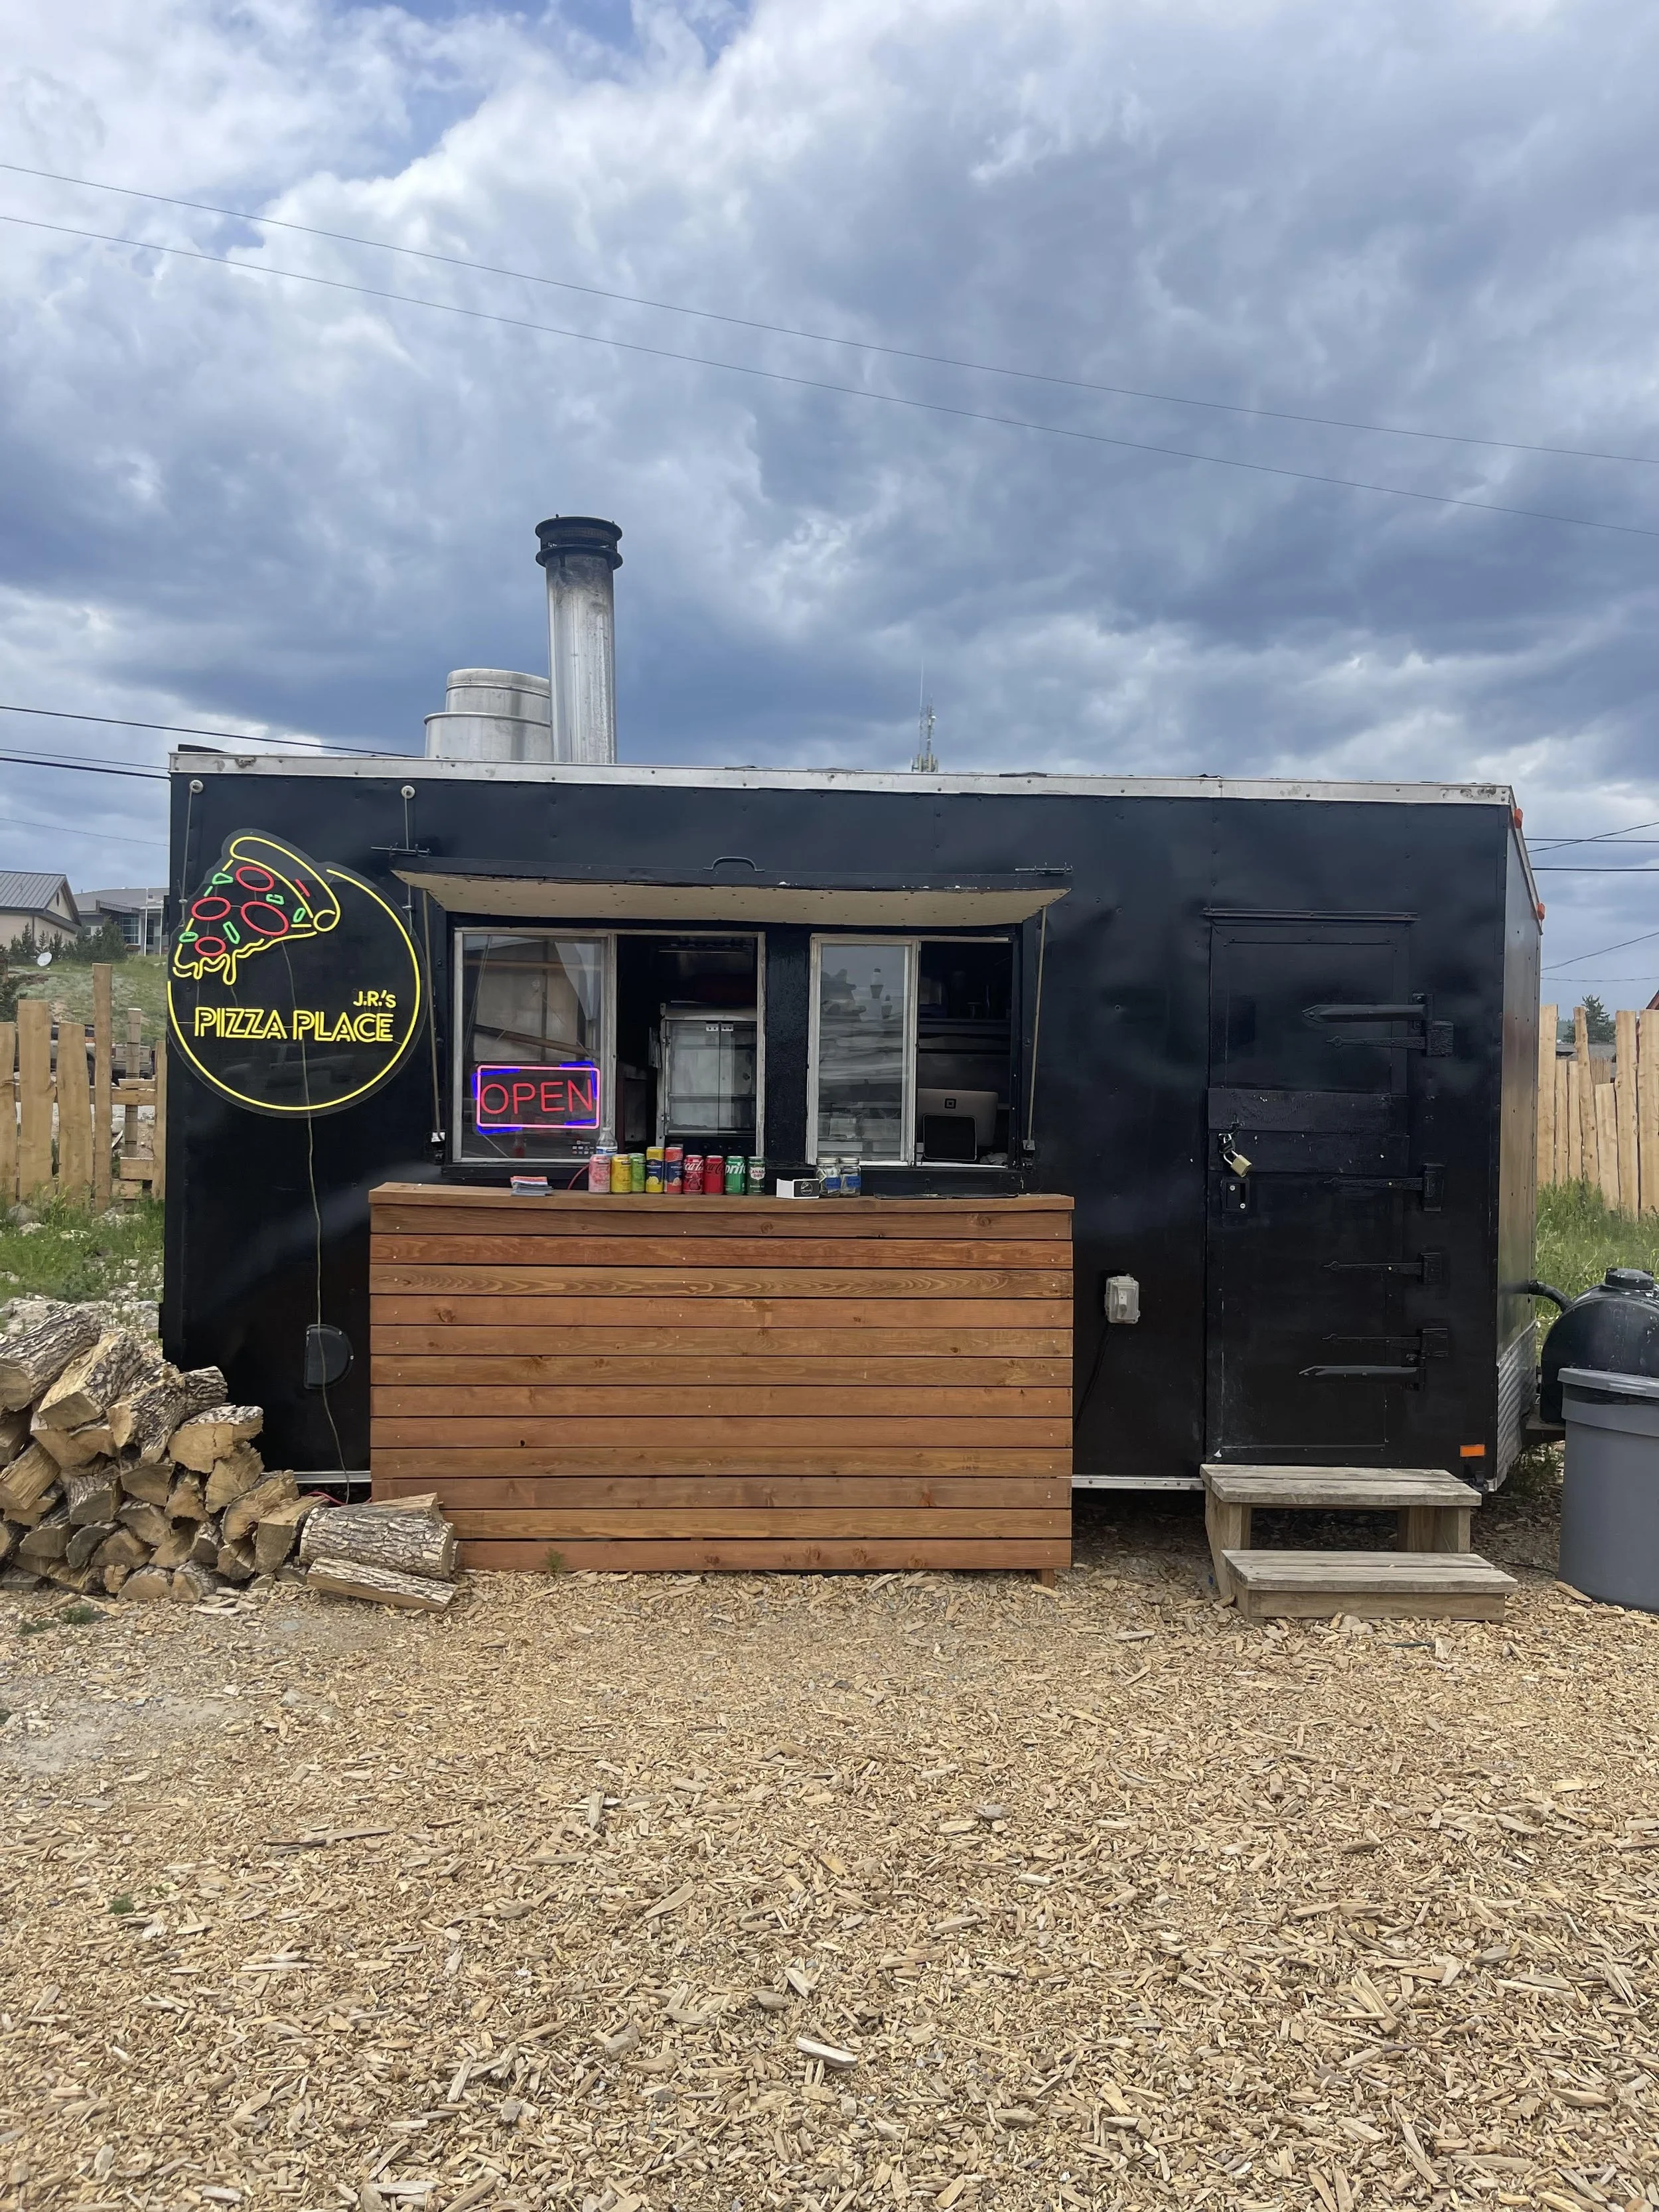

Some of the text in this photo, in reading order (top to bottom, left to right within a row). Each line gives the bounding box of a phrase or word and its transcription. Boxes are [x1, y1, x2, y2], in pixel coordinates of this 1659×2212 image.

[194, 1006, 394, 1043] PIZZA PLACE
[480, 1078, 593, 1115] OPEN
